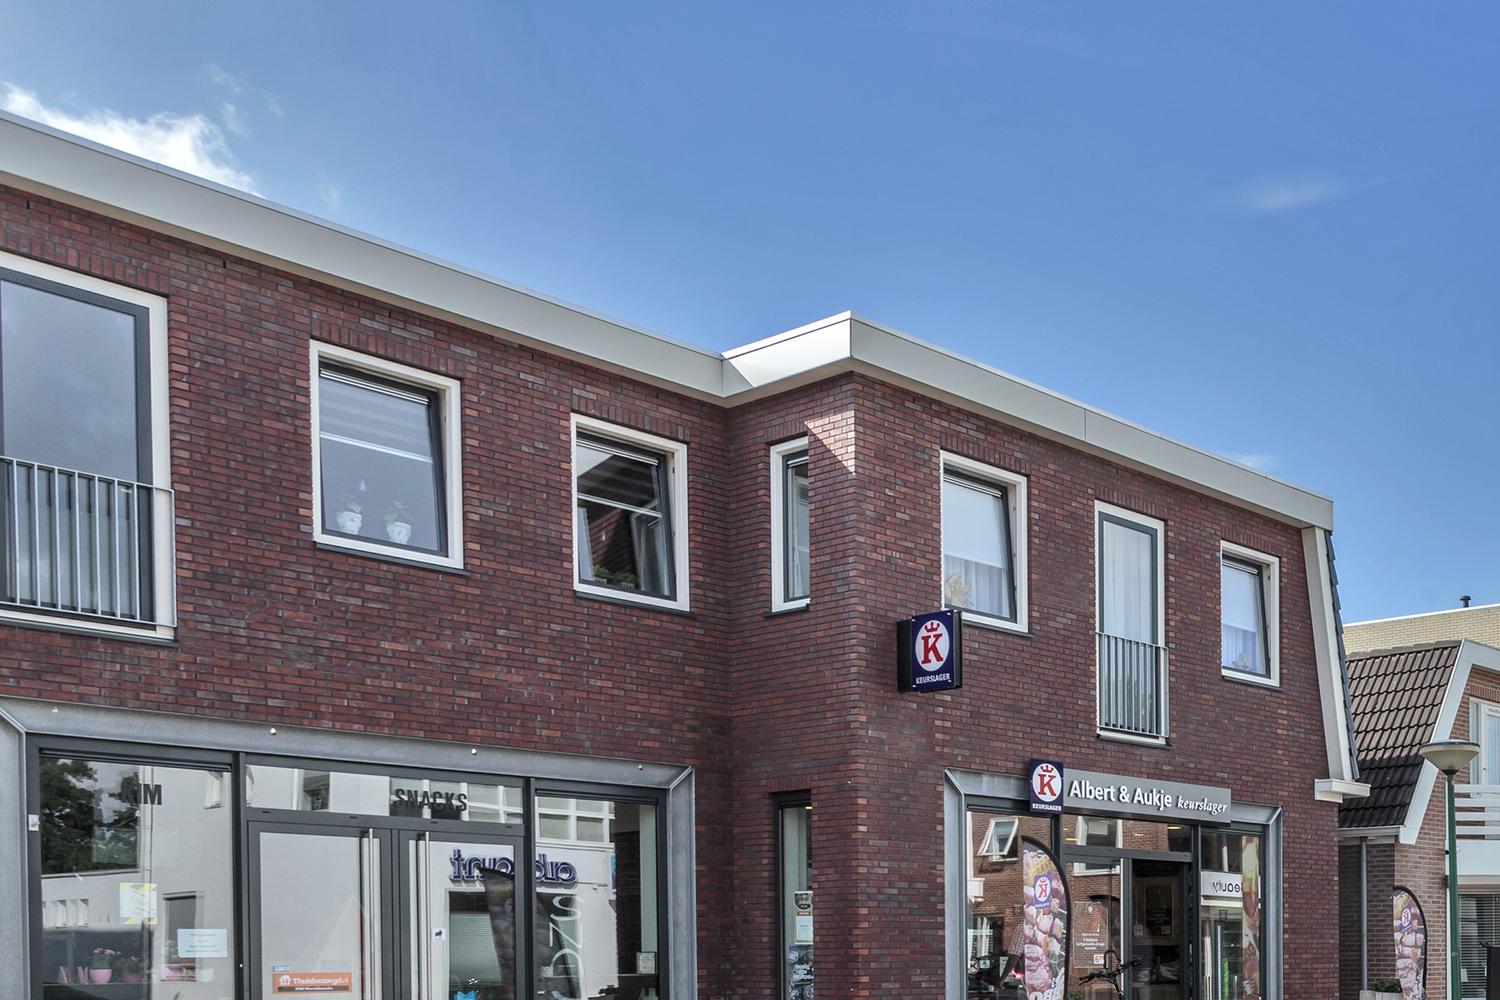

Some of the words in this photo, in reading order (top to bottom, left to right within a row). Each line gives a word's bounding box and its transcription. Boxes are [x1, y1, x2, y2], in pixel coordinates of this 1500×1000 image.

[921, 633, 944, 664] K
[915, 673, 951, 685] KEURSLAGER
[1038, 773, 1057, 797] K
[395, 788, 468, 812] SNACKS
[1032, 803, 1062, 812] KEURSLAGER
[1069, 780, 1115, 802] Albert
[1119, 785, 1130, 804] &
[1133, 787, 1173, 811] Aukje
[1177, 795, 1228, 816] keurslager
